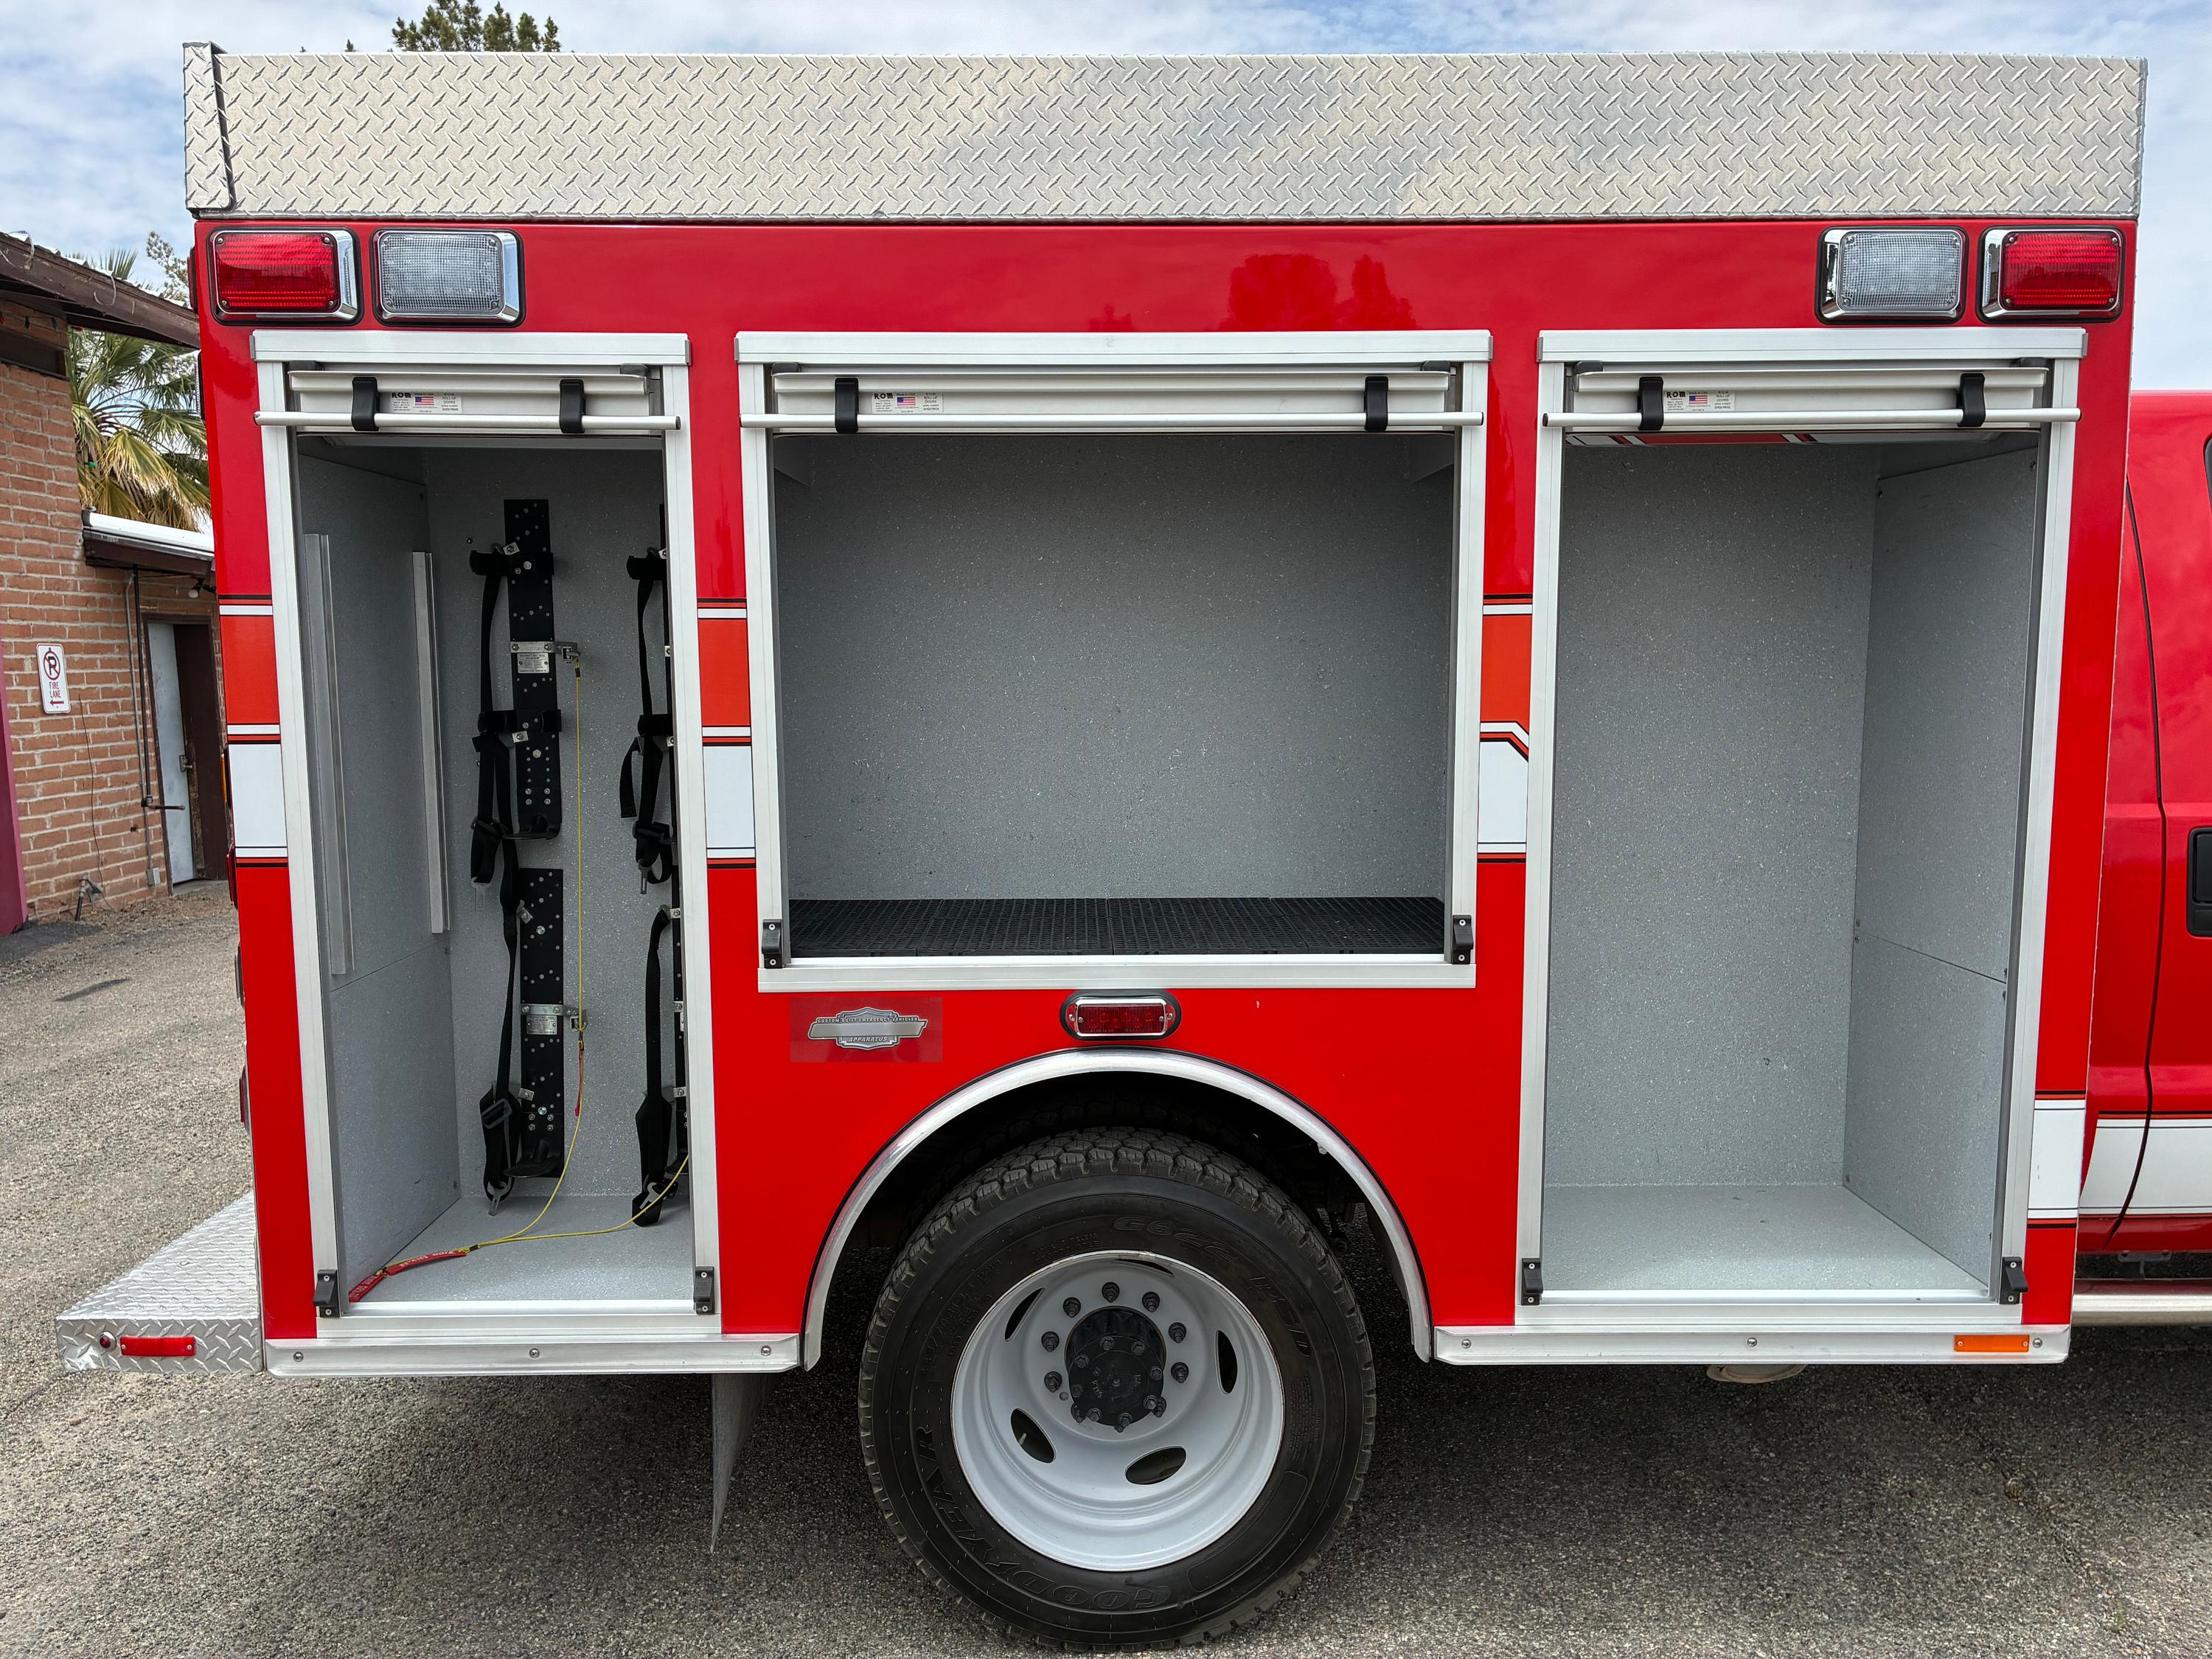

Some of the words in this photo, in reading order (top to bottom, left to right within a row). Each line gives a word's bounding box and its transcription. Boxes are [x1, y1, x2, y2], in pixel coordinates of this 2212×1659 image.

[49, 681, 60, 689] FIRE
[49, 689, 61, 698] LANE
[917, 1427, 1171, 1610] GOODYEAR
